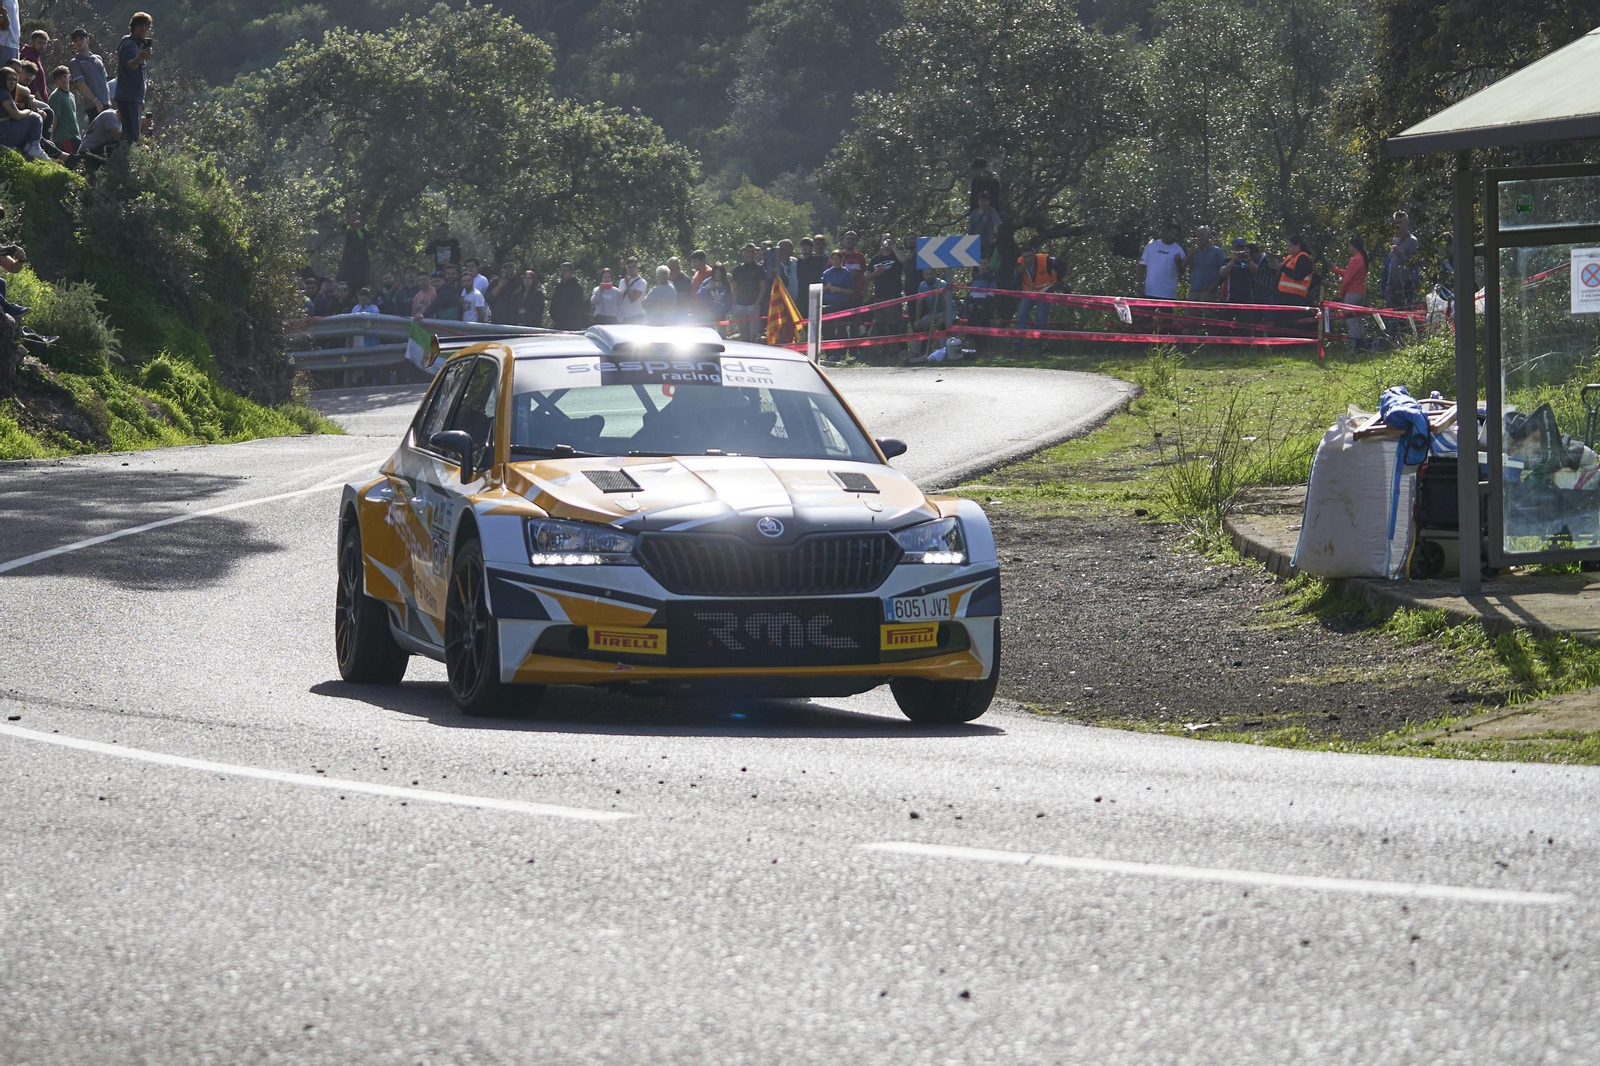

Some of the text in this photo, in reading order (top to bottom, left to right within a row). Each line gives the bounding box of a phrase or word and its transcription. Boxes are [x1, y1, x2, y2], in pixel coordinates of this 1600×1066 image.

[566, 360, 772, 375] sespande
[662, 371, 773, 384] racing team
[895, 600, 927, 618] 6051
[930, 598, 949, 616] JVZ
[594, 630, 658, 649] PIRELLI
[887, 627, 934, 644] PIRELLI
